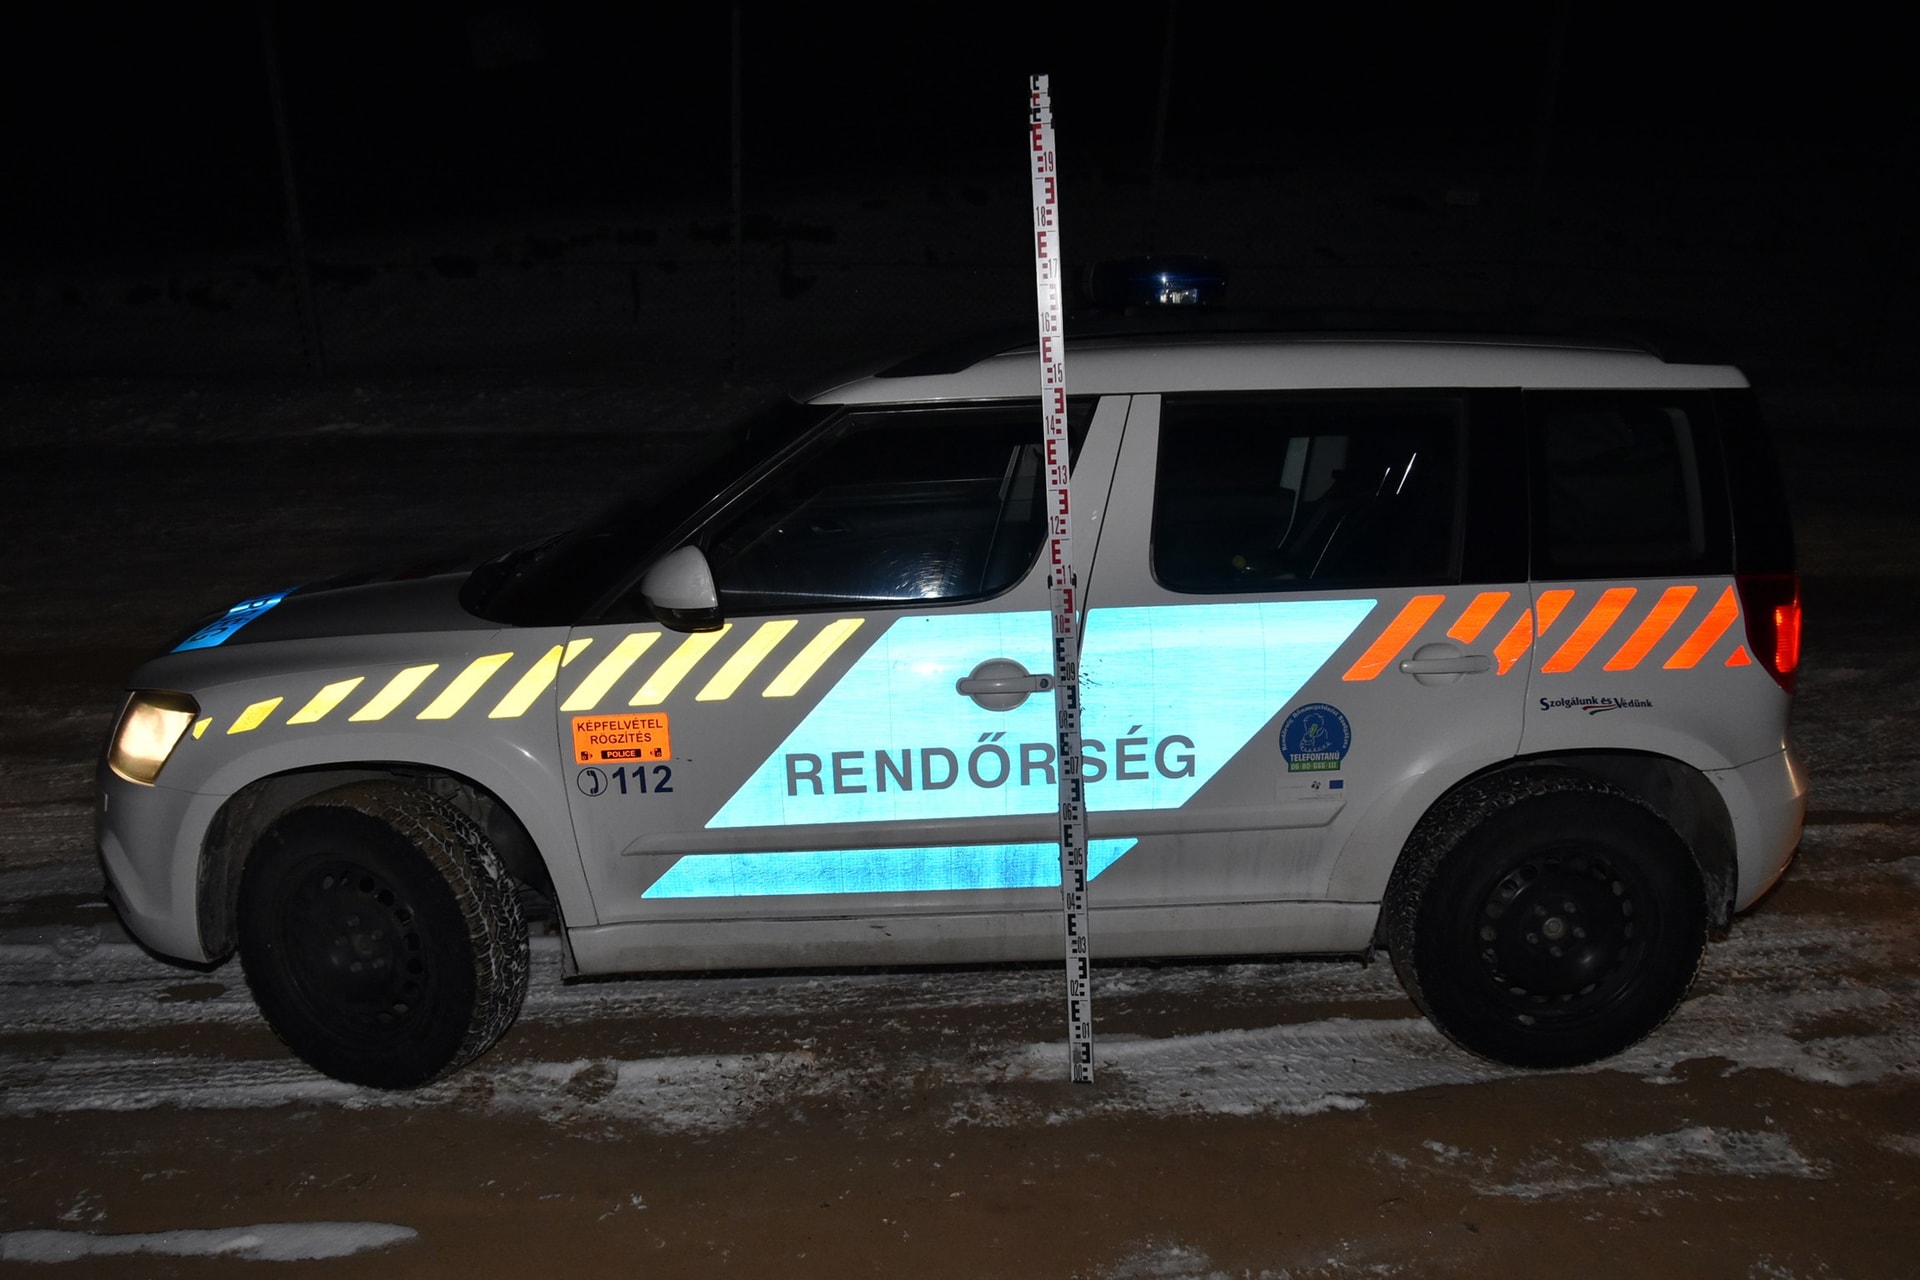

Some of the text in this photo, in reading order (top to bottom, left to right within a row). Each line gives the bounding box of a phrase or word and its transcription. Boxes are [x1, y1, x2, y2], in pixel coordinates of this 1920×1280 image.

[1043, 151, 1054, 172] 19
[1036, 206, 1046, 227] 18
[1040, 312, 1050, 332] 16
[1053, 363, 1064, 383] 15
[1045, 415, 1056, 435] 14
[1057, 465, 1068, 485] 13
[1050, 515, 1060, 535] 12
[1062, 565, 1072, 585] 11
[1055, 614, 1065, 634] 10
[1065, 662, 1076, 681] 09
[1540, 696, 1653, 711] Szolgálunk és Védünk
[577, 717, 663, 732] KÉPFELVÉTEL
[1059, 711, 1069, 729] 08
[590, 731, 652, 745] RÖGZÍTÉS
[606, 750, 637, 759] POLICE
[785, 724, 1196, 797] RENDŐRSÉG
[1290, 751, 1340, 761] TELEFONTANÚ
[1070, 757, 1080, 775] 07
[612, 765, 673, 794] 112
[1062, 803, 1072, 821] 06
[1074, 847, 1083, 865] 05
[1066, 893, 1076, 910] 04
[1077, 936, 1087, 954] 03
[1070, 979, 1079, 997] 02
[1081, 1022, 1090, 1039] 01
